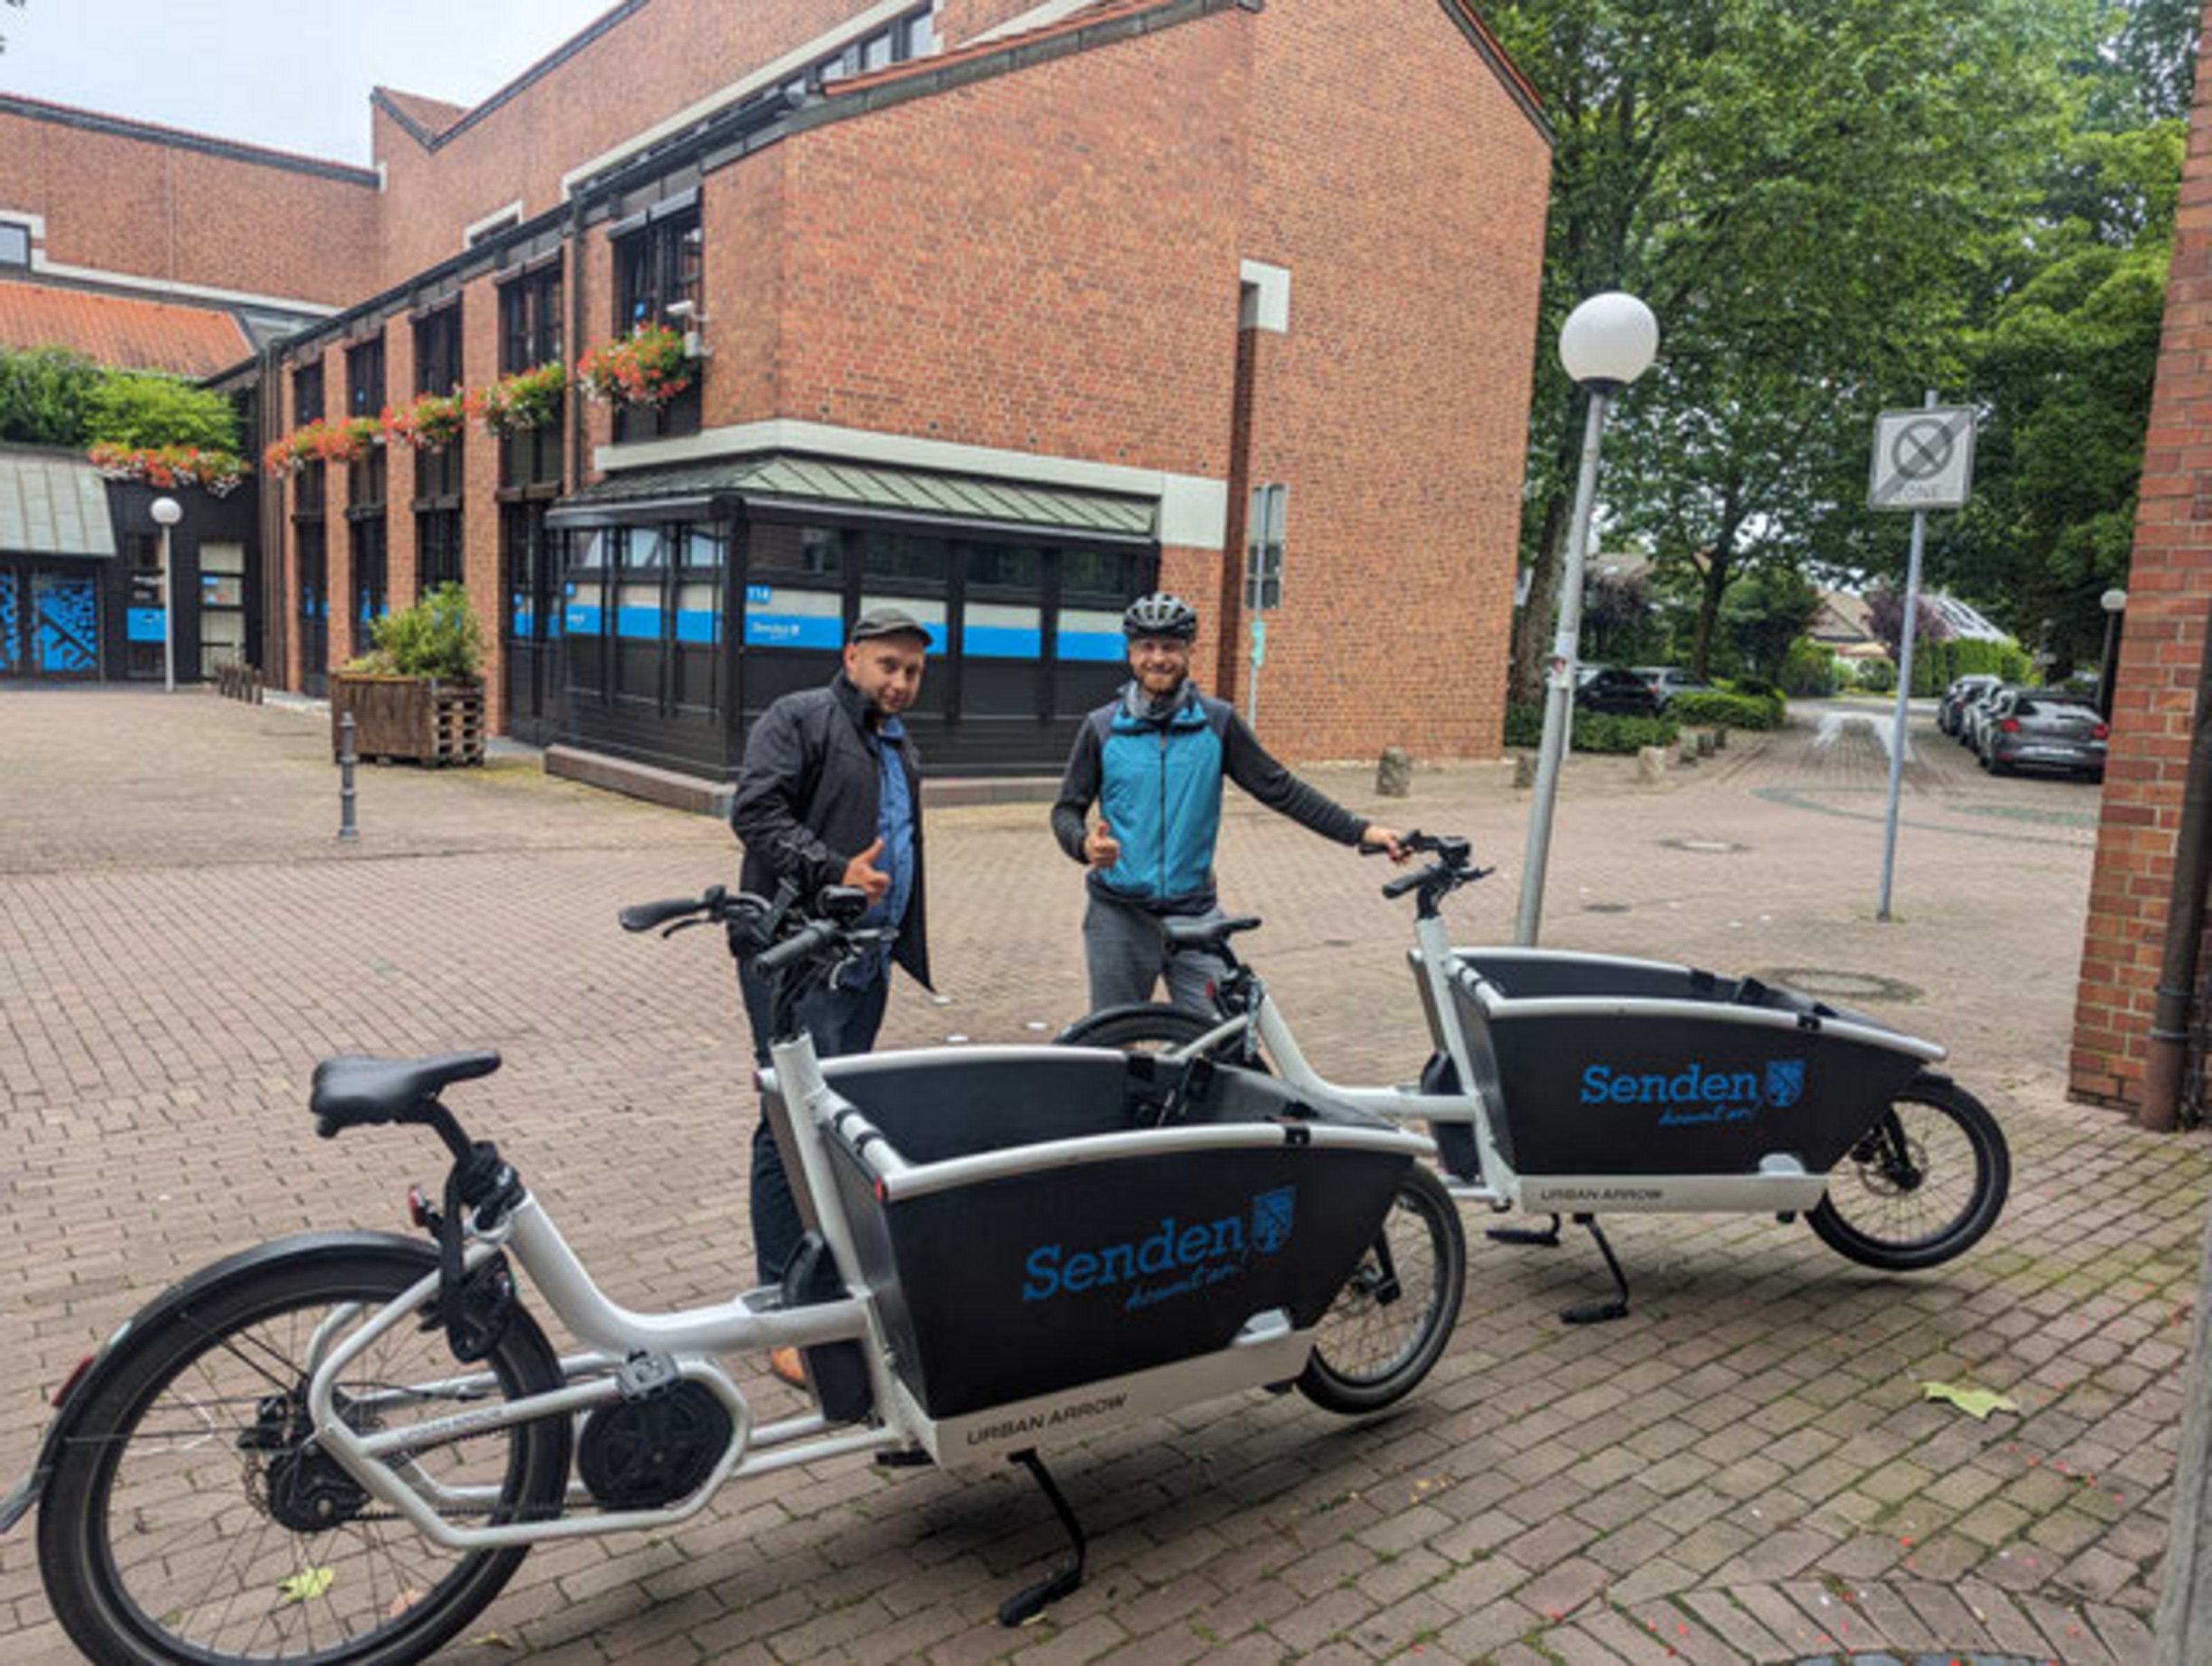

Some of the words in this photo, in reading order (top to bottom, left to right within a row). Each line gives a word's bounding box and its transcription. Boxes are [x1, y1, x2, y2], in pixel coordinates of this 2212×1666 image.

[1580, 1064, 1756, 1103] Senden
[1023, 1216, 1244, 1301] Senden
[966, 1414, 1045, 1445] URBAN
[1047, 1394, 1128, 1426] ARROW
